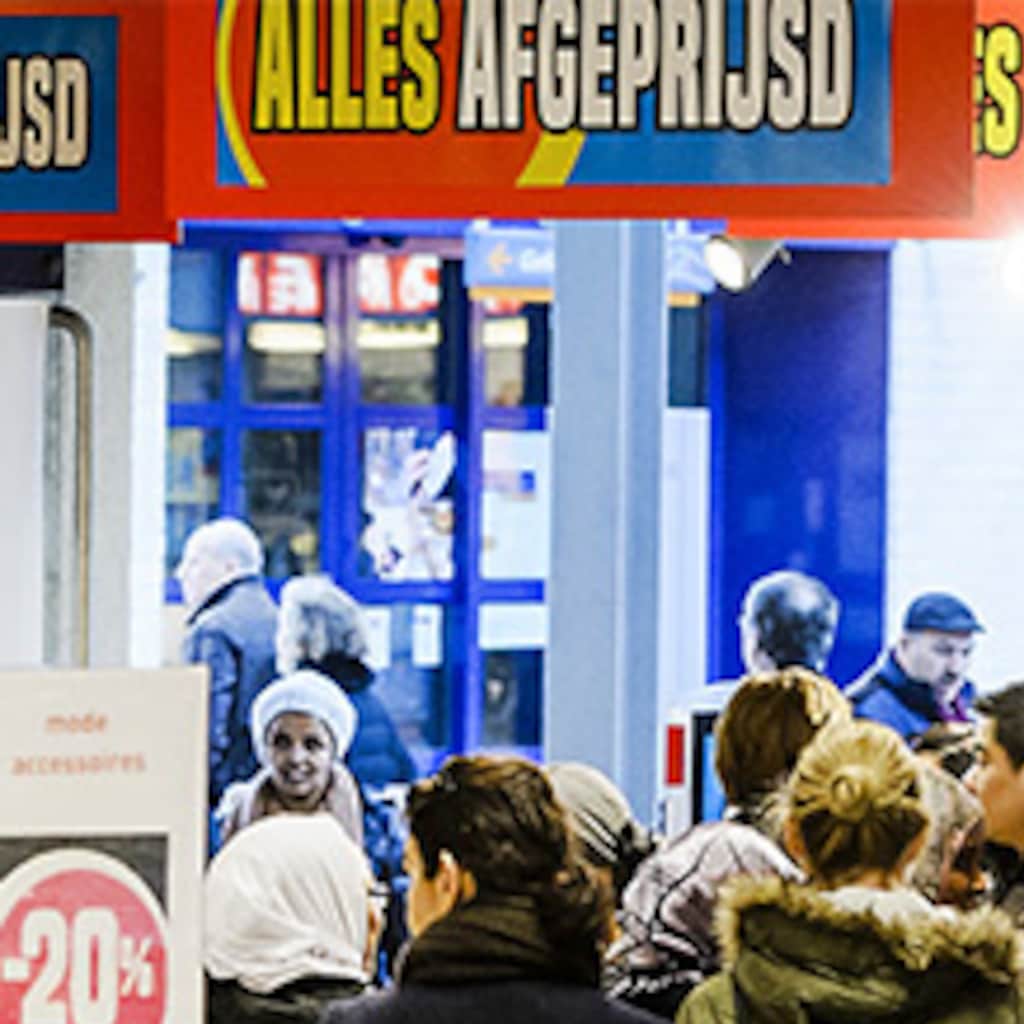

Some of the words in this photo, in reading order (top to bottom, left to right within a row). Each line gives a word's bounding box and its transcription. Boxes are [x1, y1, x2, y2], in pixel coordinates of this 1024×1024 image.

[252, 0, 441, 132] ALLES
[456, 0, 854, 131] AFGEPRIJSD
[45, 713, 108, 734] mode
